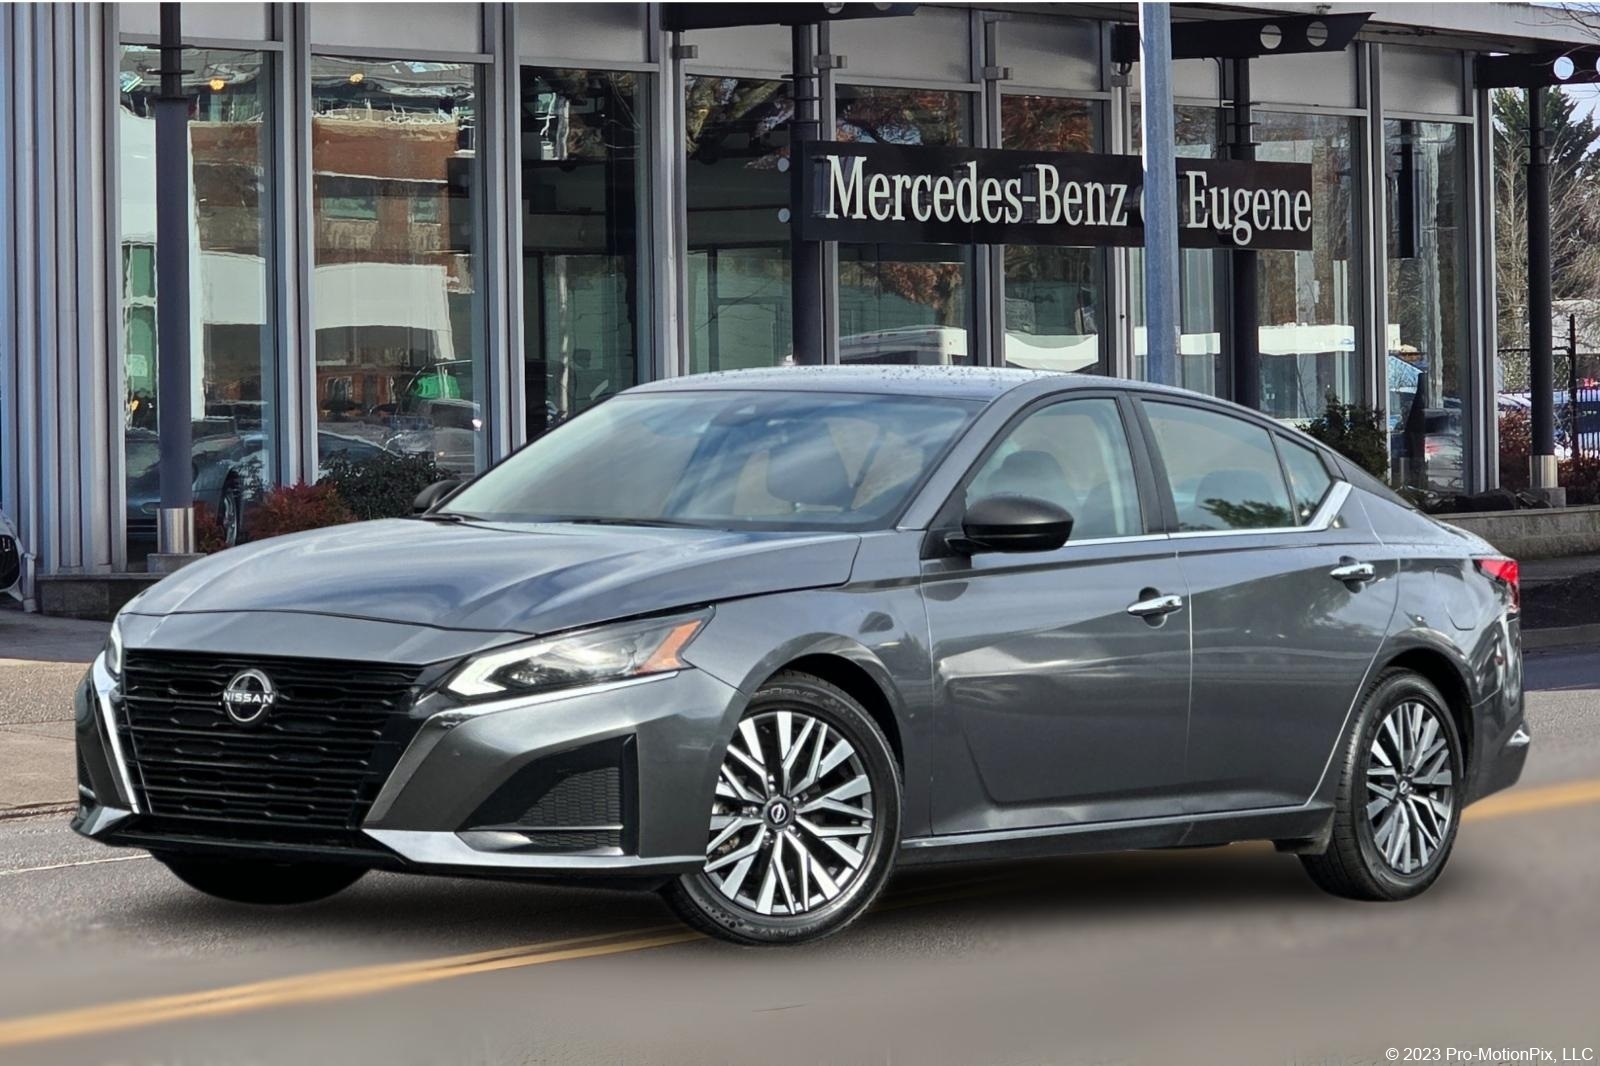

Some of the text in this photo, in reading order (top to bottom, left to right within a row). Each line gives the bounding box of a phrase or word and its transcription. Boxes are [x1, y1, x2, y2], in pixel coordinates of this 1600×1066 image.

[825, 155, 1127, 226] Mercedes-Benz
[1186, 171, 1311, 245] Eugene
[223, 692, 273, 704] NISSAN
